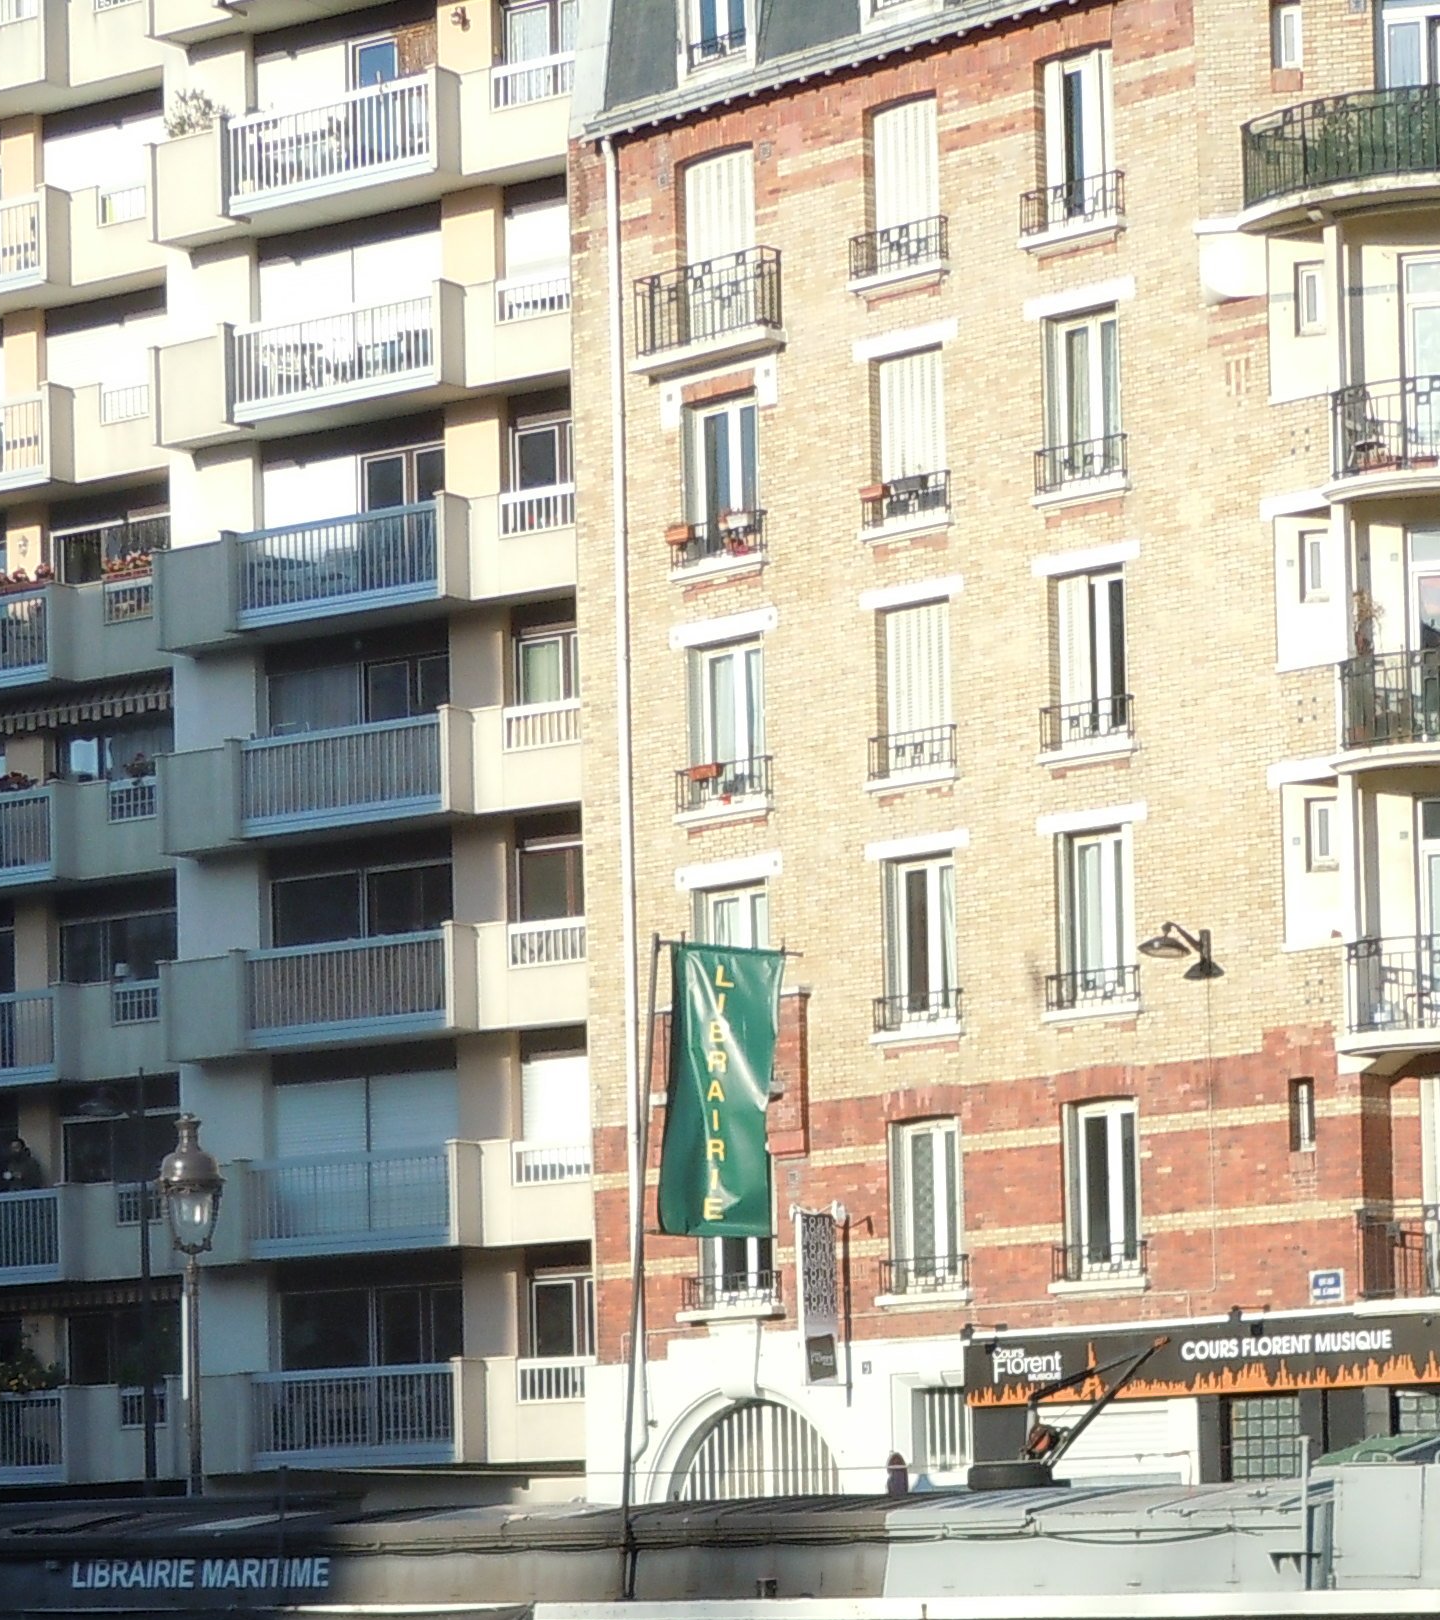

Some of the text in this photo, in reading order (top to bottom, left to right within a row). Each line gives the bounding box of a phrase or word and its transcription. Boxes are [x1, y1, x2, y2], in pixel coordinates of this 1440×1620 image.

[703, 964, 735, 1221] LIBRAIRIE
[992, 1347, 1024, 1359] Cours
[1181, 1329, 1393, 1360] COURS FLORENT MUSIQUE
[993, 1351, 1062, 1384] Florent
[71, 1557, 330, 1589] LIBRAIRIE MARITIME
